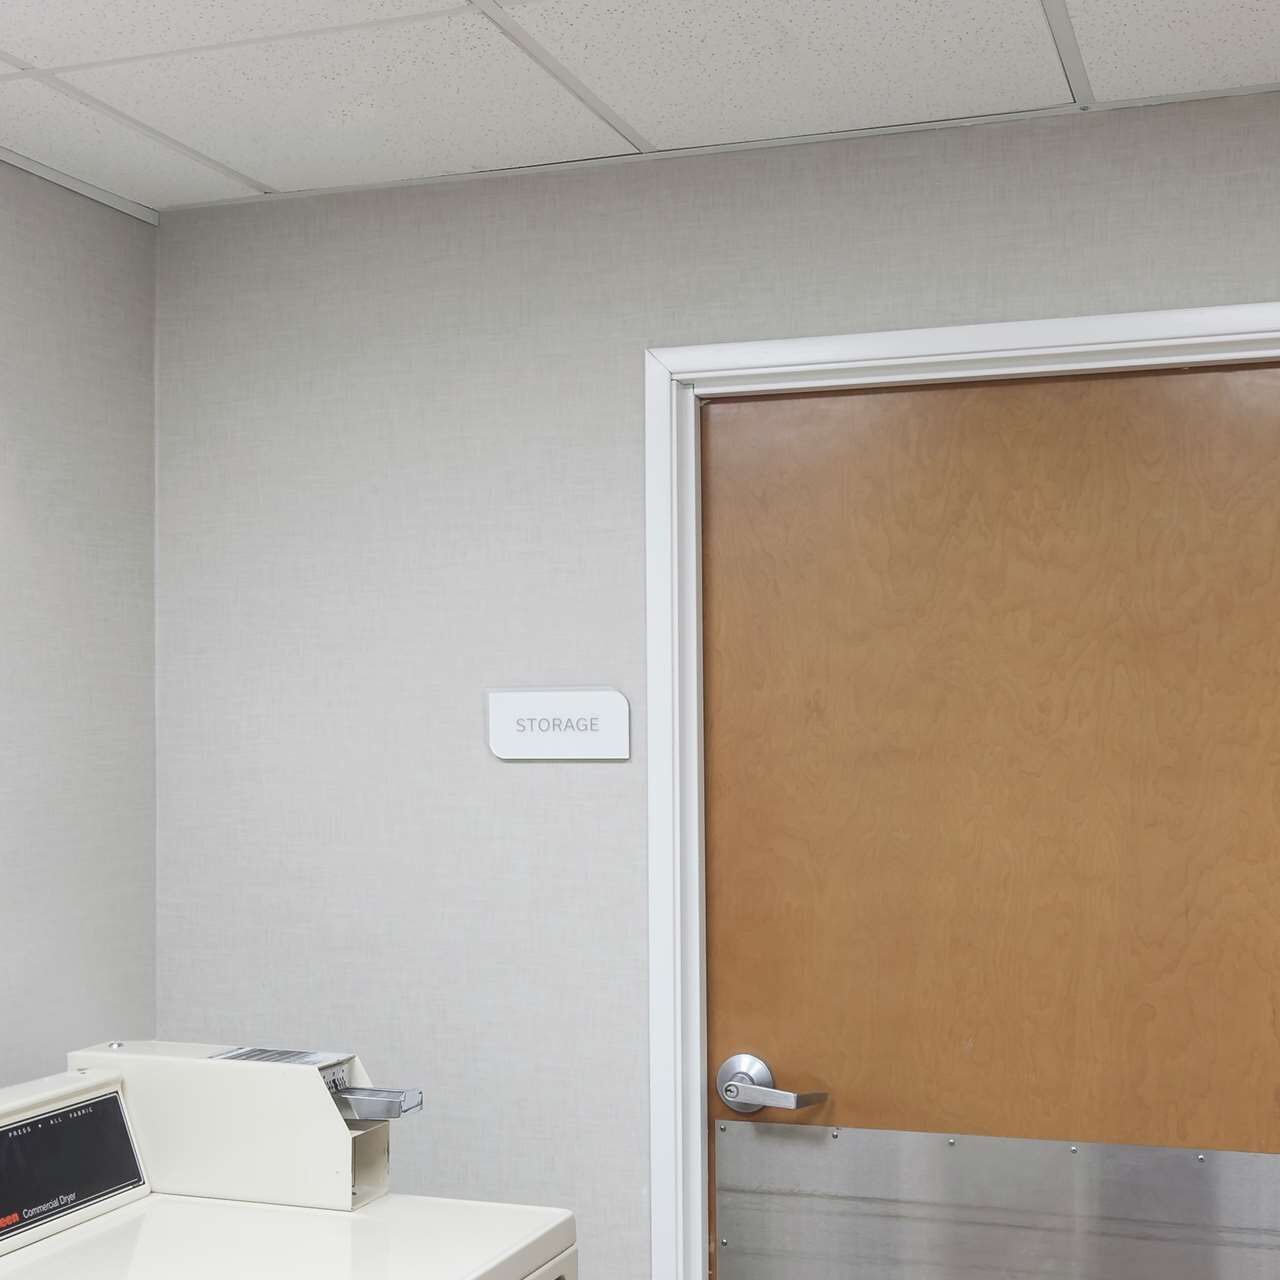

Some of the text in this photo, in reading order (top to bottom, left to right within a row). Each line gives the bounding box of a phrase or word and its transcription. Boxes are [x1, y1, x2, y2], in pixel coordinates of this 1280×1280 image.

[516, 717, 600, 732] STORAGE
[22, 1197, 59, 1219] Commercial
[59, 1192, 77, 1207] Dryer
